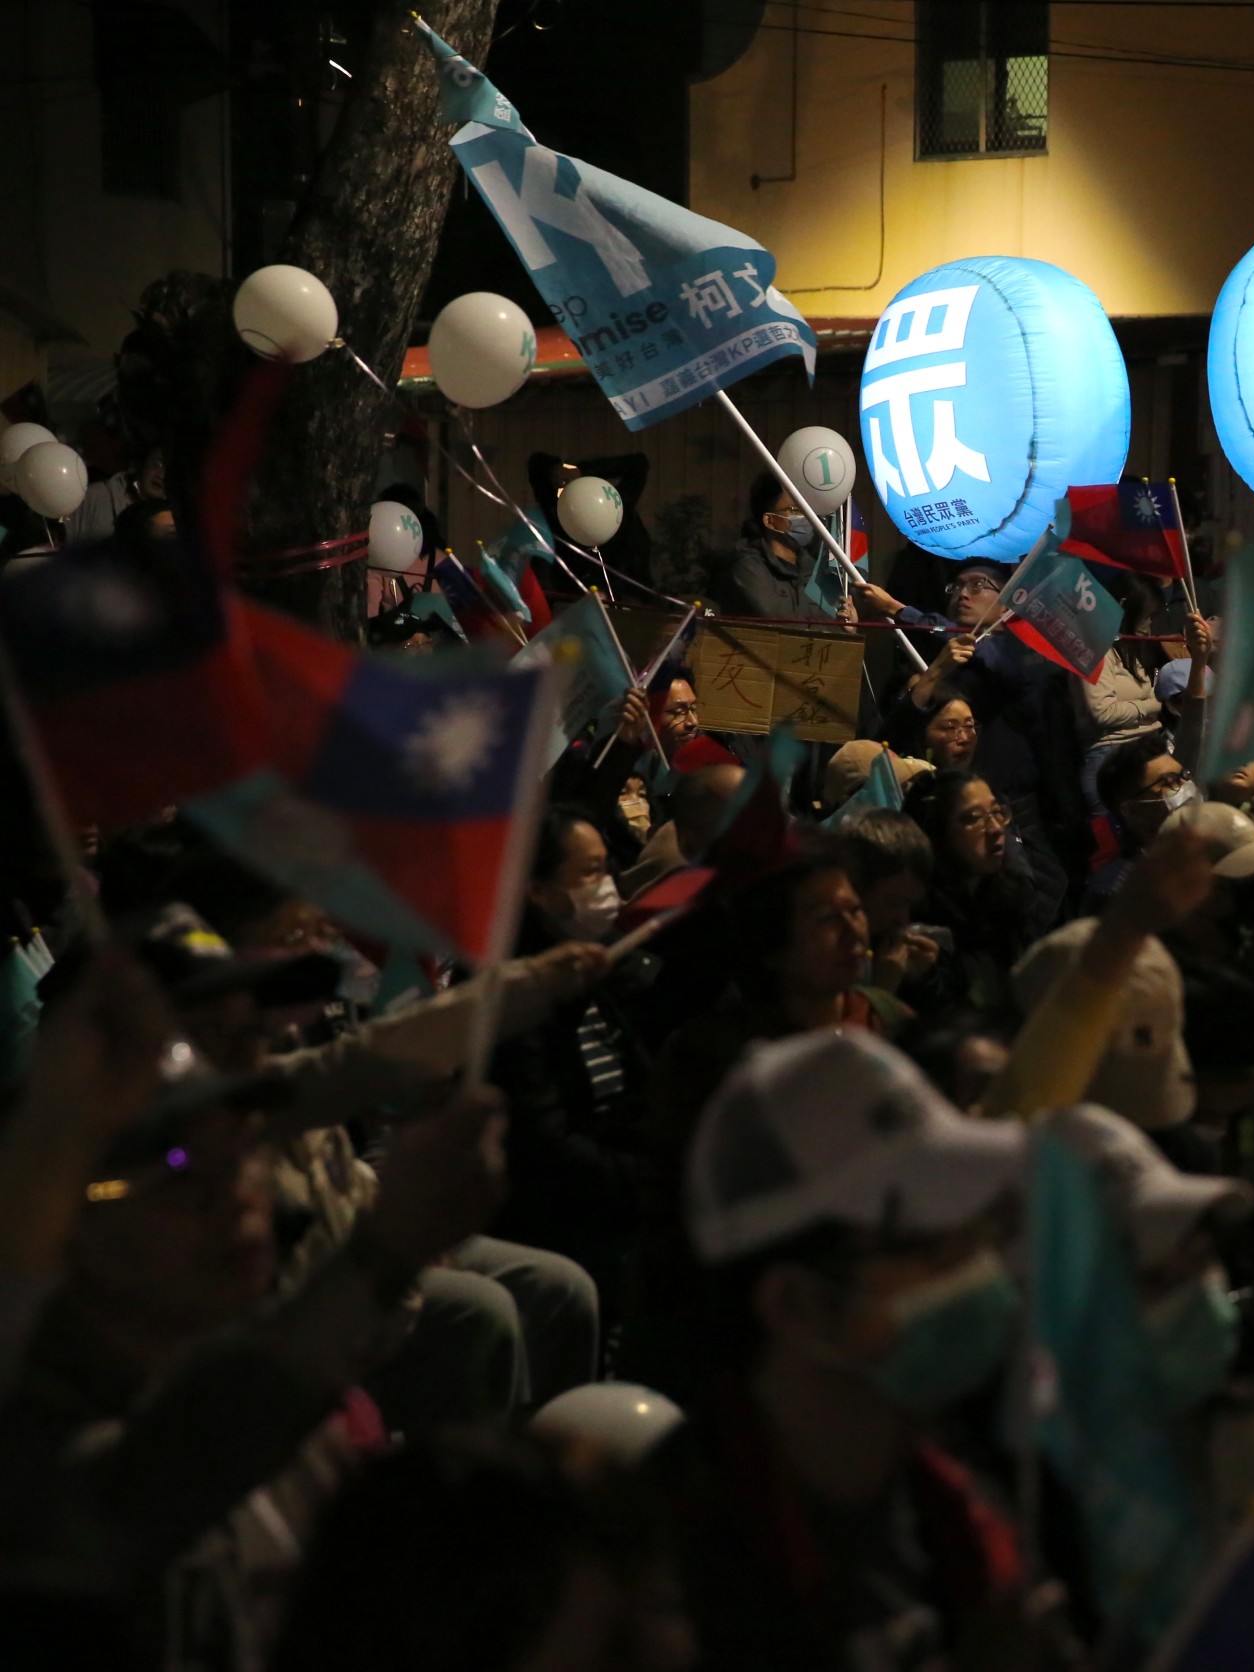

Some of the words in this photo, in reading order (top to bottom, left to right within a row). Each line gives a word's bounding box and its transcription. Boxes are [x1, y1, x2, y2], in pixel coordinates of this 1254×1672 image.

[862, 285, 990, 505] 眾
[815, 451, 833, 485] 1
[904, 499, 974, 528] 台灣民眾黨
[958, 518, 980, 528] PARTY
